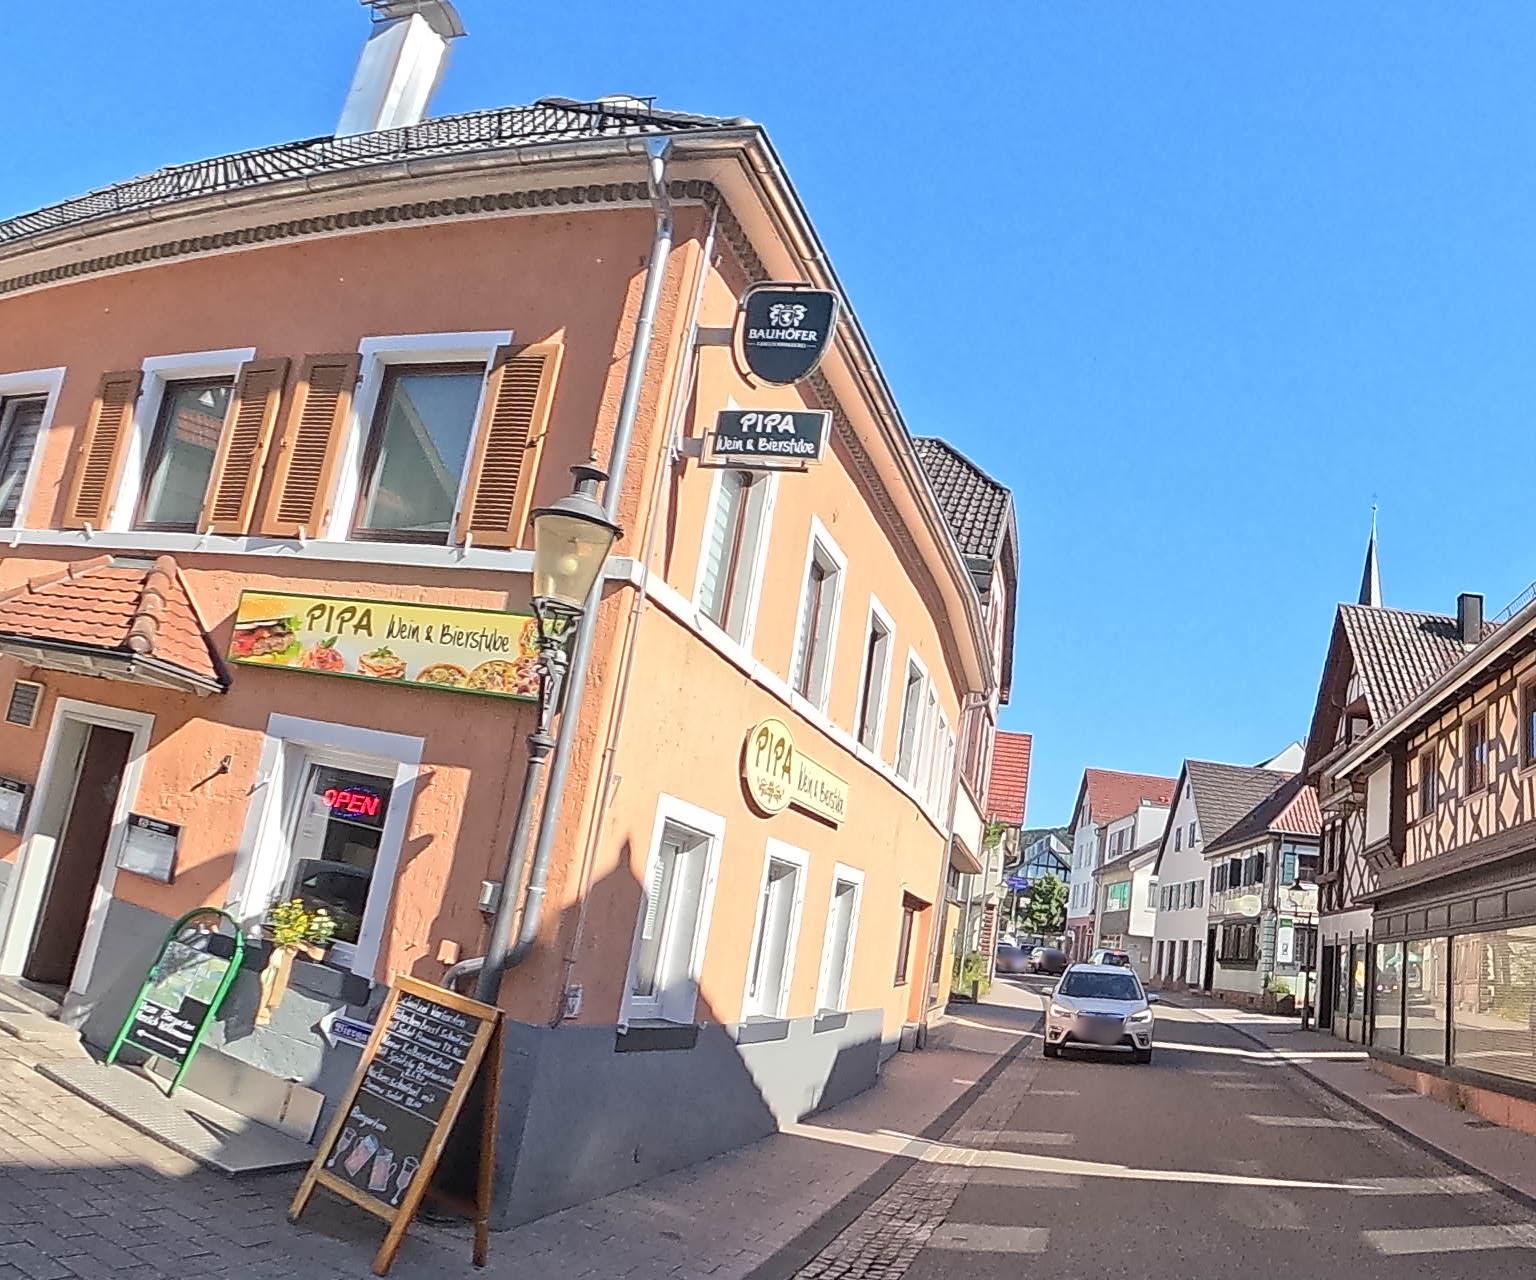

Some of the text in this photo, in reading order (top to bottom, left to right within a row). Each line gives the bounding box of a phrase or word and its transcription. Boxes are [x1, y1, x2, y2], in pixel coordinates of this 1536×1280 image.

[748, 327, 818, 342] BAUHÖFER
[740, 413, 796, 434] PIPA
[716, 435, 744, 452] Wein
[758, 436, 815, 455] Bierstube
[306, 603, 510, 653] PIPA Wein & Bierstube
[755, 726, 793, 785] PIPA
[321, 789, 380, 816] OPEN
